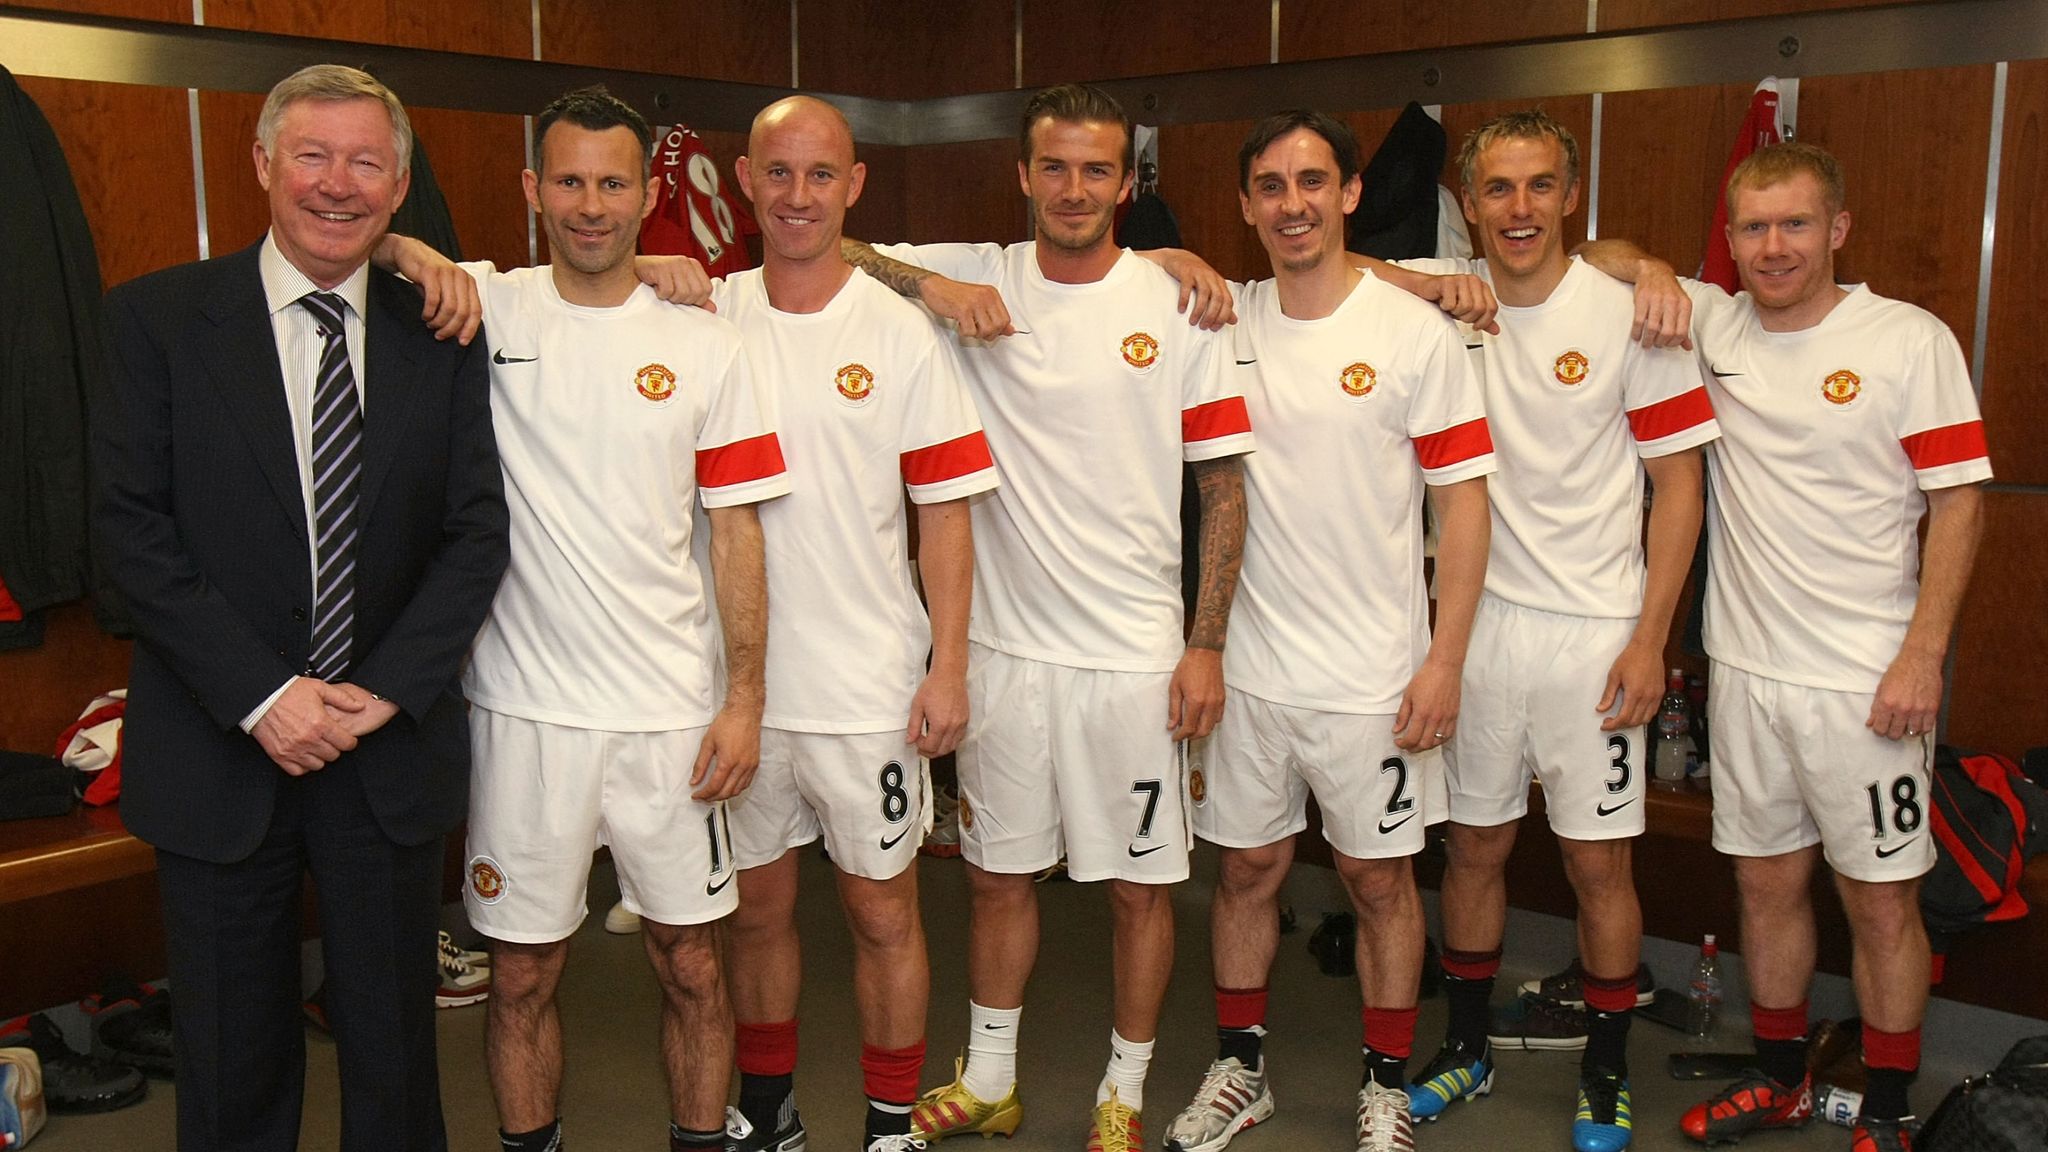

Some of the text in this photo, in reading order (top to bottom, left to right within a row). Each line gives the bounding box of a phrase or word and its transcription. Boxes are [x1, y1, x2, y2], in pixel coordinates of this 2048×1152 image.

[877, 760, 911, 824] 8
[1380, 754, 1415, 816] 2
[1604, 733, 1632, 794] 3
[1131, 779, 1162, 838] 7
[1864, 773, 1923, 840] 18
